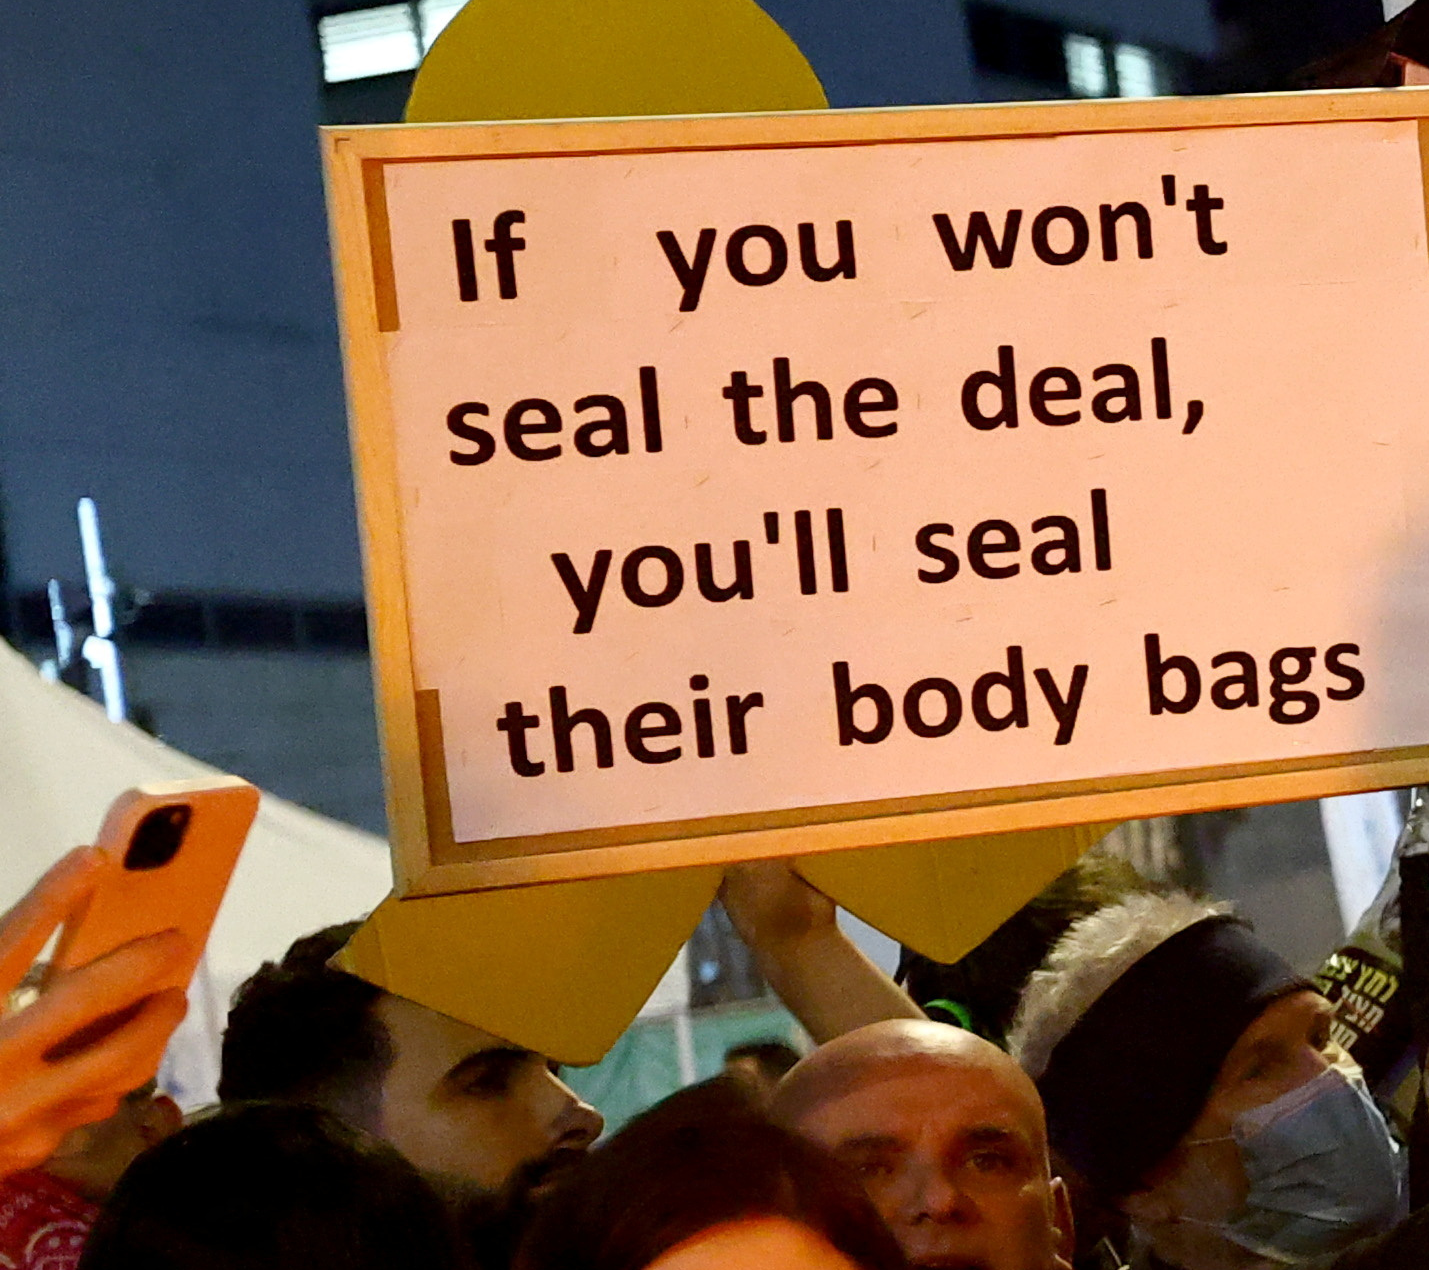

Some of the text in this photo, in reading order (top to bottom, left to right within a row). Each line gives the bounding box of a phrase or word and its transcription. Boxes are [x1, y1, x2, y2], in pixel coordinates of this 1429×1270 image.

[452, 175, 1229, 312] If you won't
[446, 336, 1205, 466] seal the deal,
[551, 488, 1113, 634] you'll seal
[497, 633, 1366, 778] their body bags
